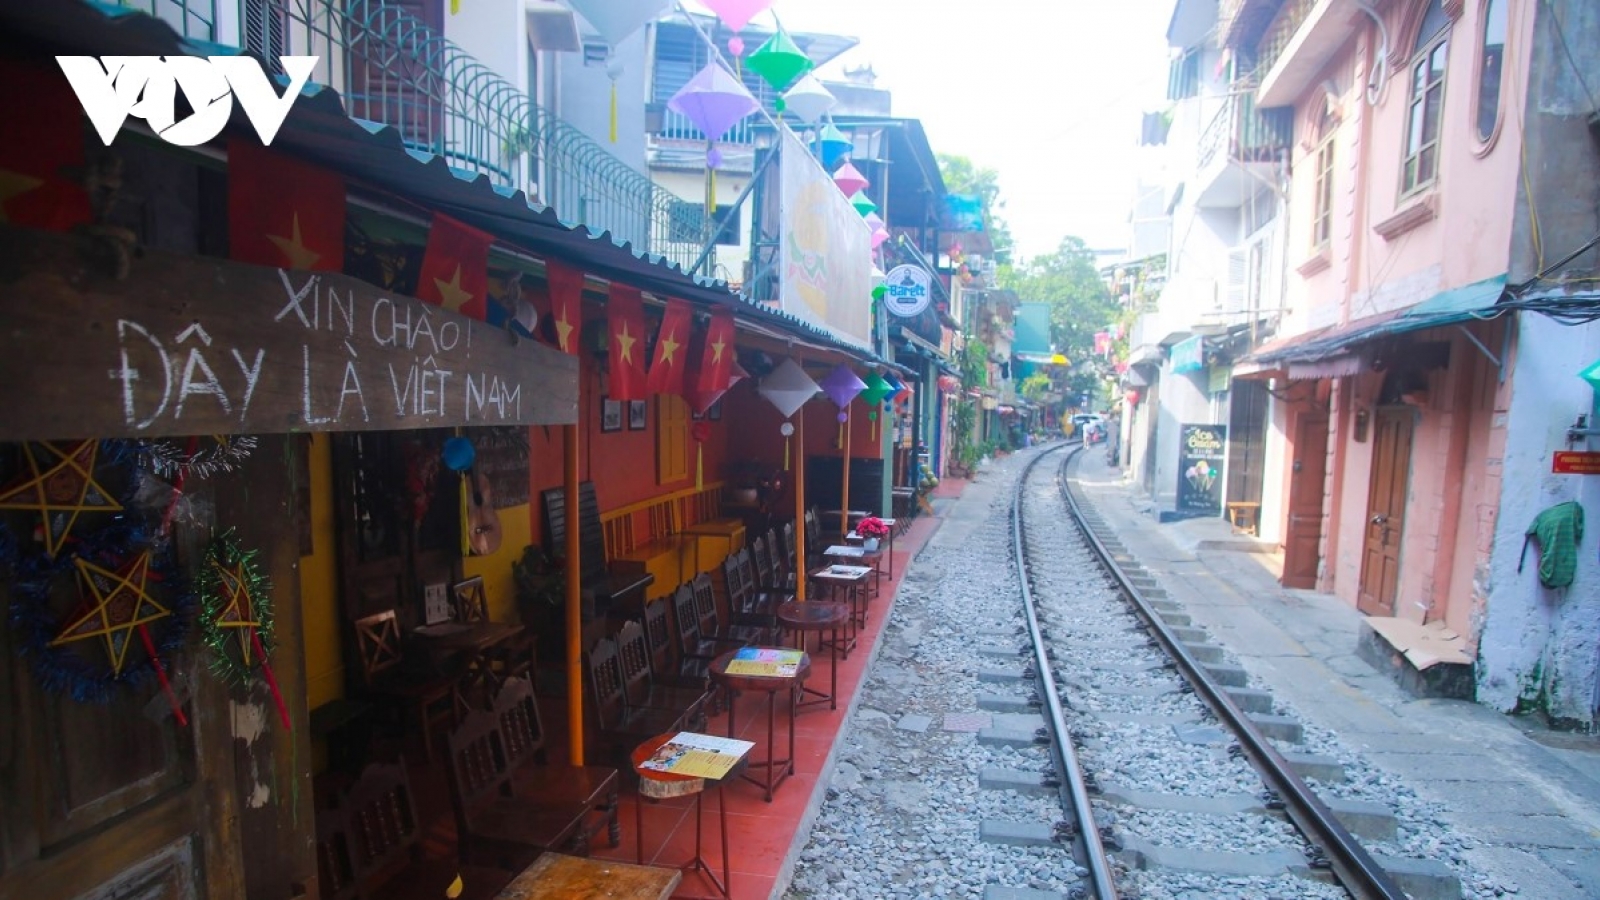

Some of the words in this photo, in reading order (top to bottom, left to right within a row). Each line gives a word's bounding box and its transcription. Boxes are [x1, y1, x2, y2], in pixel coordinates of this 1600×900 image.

[274, 268, 354, 335] XIN
[108, 319, 265, 429] ĐÂY
[303, 339, 370, 424] LÀ
[388, 354, 453, 422] VIỆT
[465, 372, 521, 421] NAM
